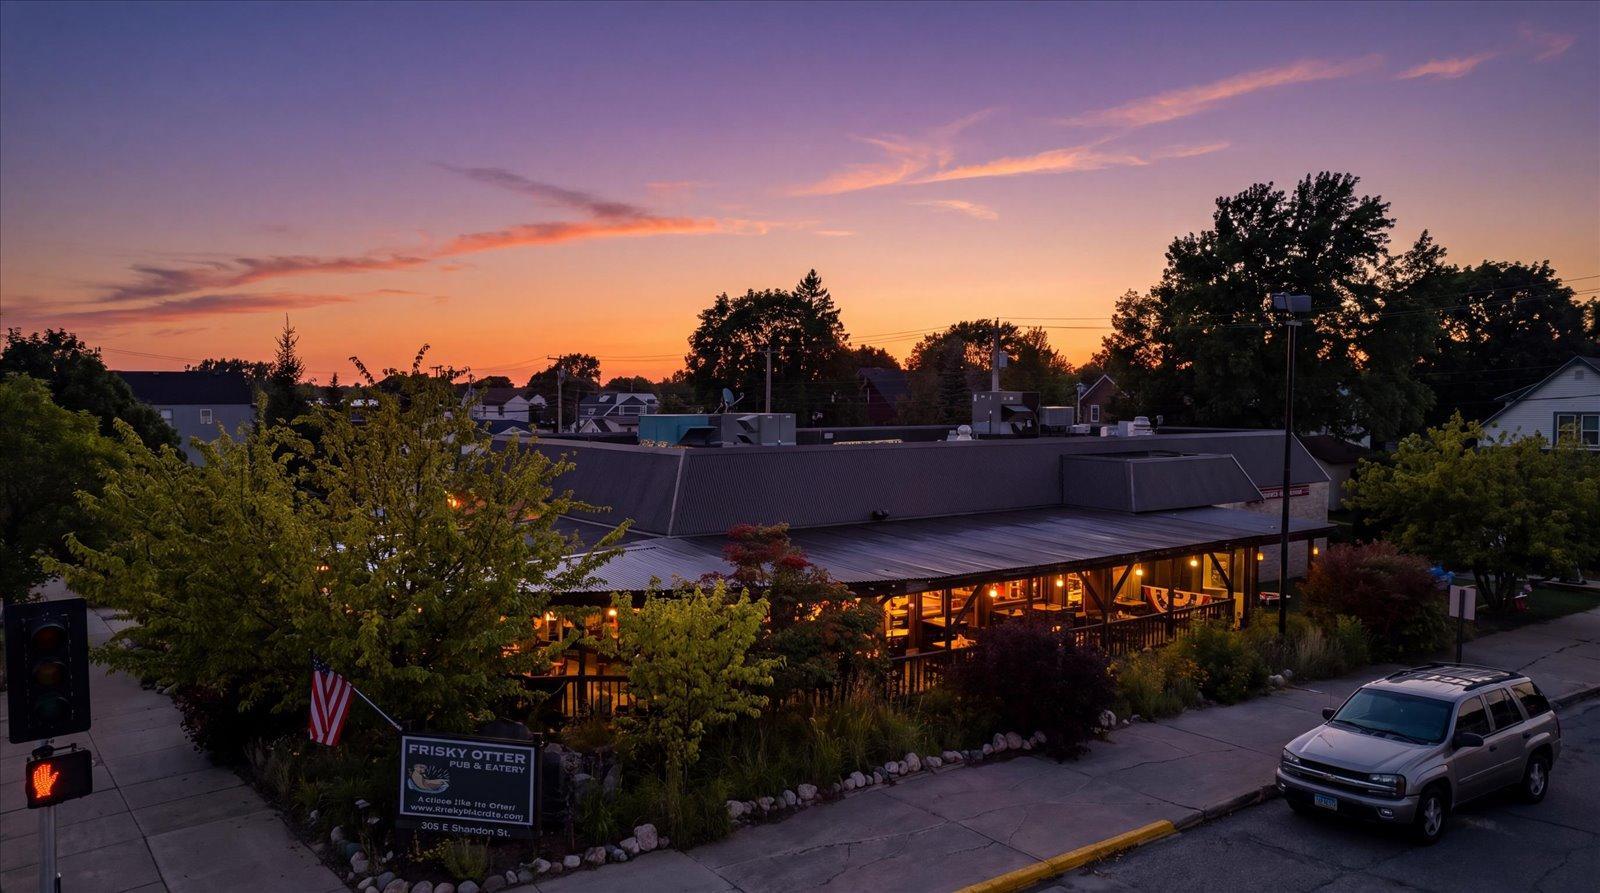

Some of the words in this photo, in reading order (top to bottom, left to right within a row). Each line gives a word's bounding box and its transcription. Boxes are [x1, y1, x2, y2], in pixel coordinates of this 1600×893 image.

[408, 744, 467, 759] FRISKY
[471, 750, 526, 764] OTTER
[449, 760, 471, 769] PUB
[473, 762, 482, 770] &
[485, 764, 526, 774] EATERY
[442, 823, 449, 831] E
[452, 824, 494, 836] Shandon
[496, 828, 511, 837] St.
